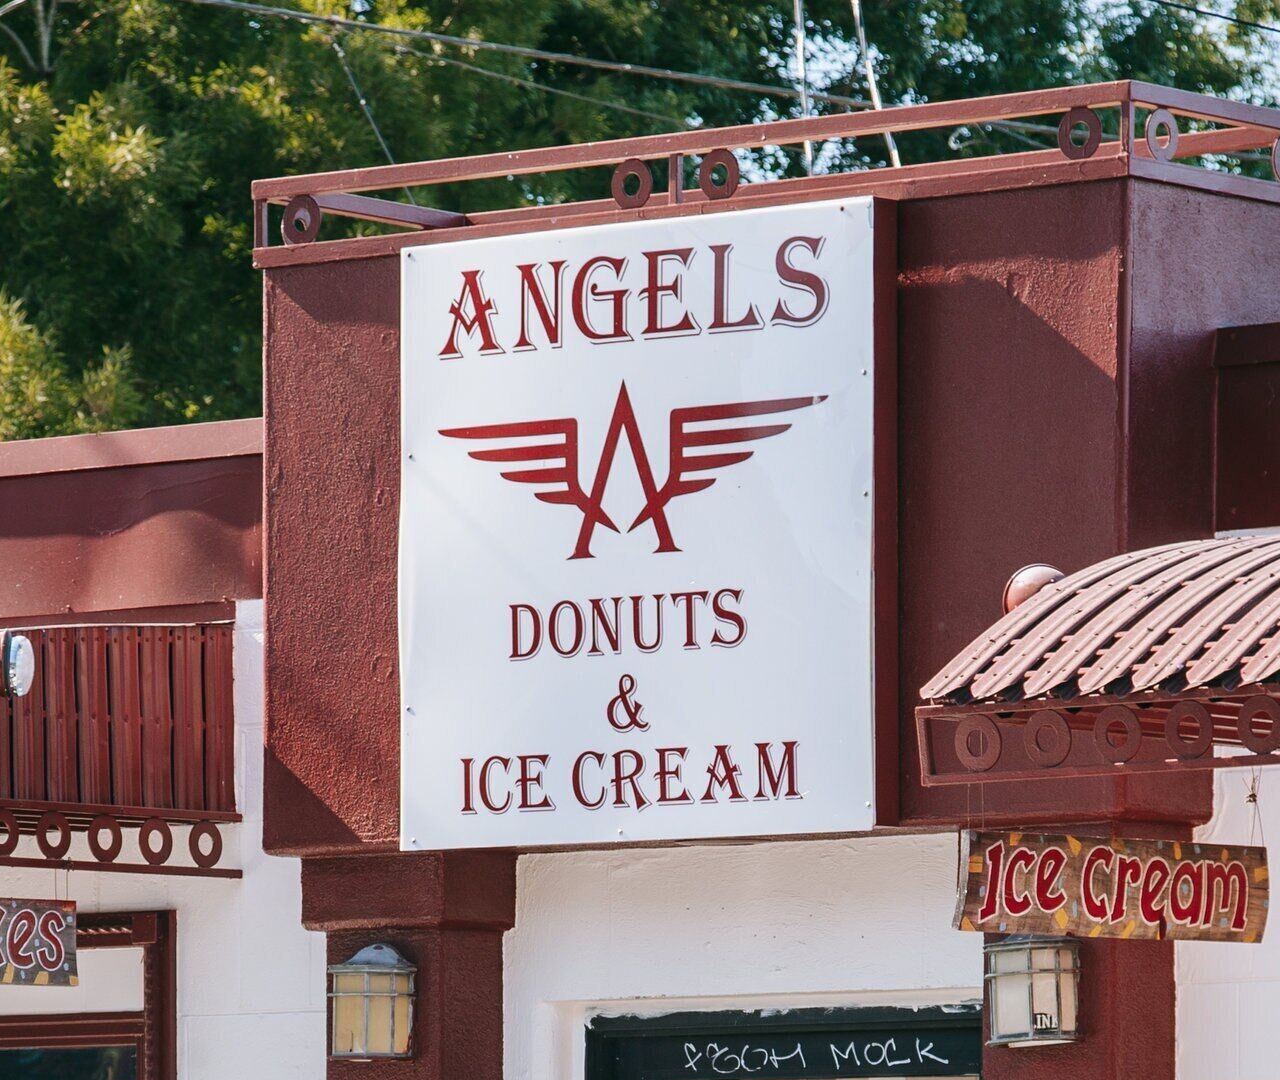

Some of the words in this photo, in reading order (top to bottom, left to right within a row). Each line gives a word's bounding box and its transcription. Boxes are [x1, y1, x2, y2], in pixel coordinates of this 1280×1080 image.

[438, 236, 830, 360] ANGELS
[508, 588, 747, 662] DONUTS
[607, 674, 650, 732] &
[460, 753, 556, 816] ICE
[572, 740, 805, 813] CREAM
[978, 840, 1068, 925] Ice
[1081, 845, 1249, 931] Cream
